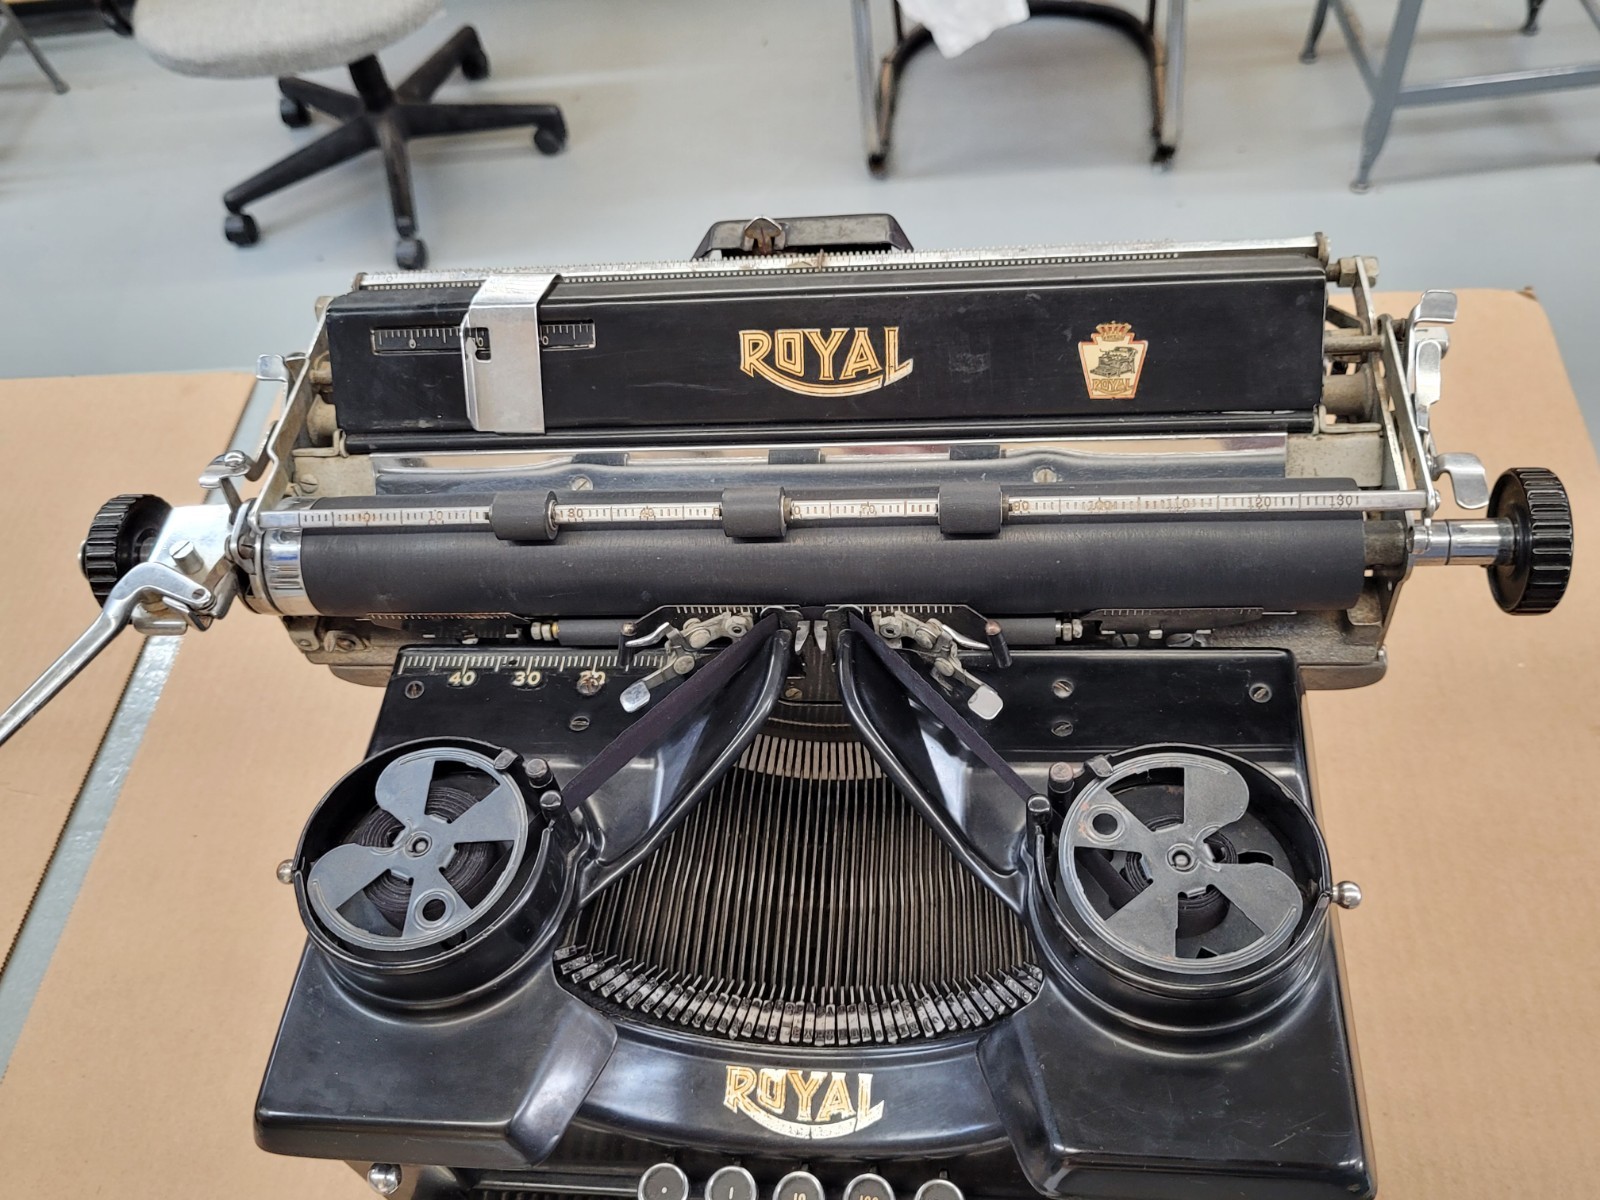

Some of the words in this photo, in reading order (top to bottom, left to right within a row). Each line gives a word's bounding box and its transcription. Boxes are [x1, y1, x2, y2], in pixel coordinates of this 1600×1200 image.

[739, 326, 914, 397] ROYAL
[1091, 377, 1134, 396] ROYAL
[448, 671, 476, 686] 40
[512, 671, 542, 686] 30
[723, 1065, 885, 1140] ROYAL
